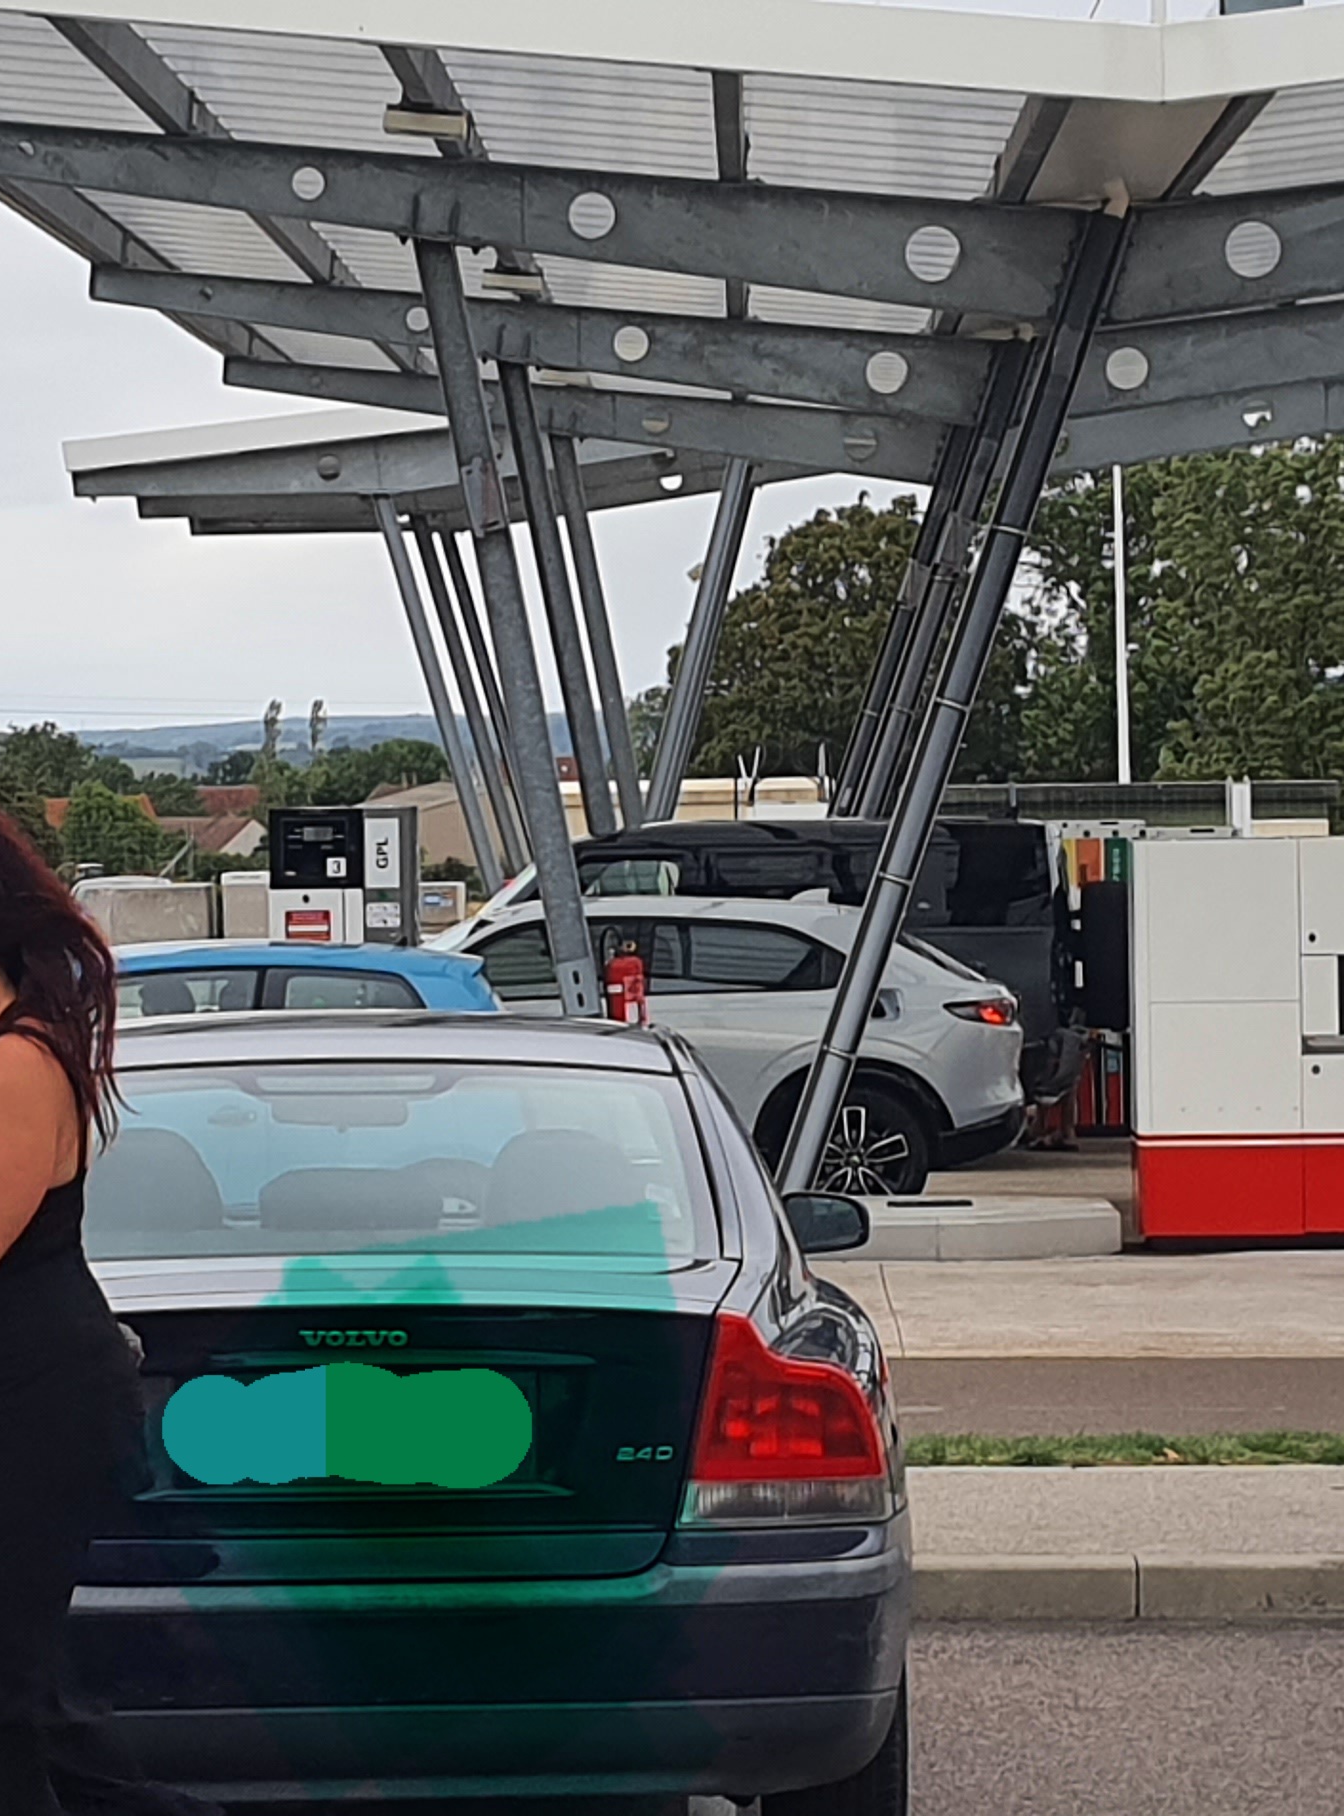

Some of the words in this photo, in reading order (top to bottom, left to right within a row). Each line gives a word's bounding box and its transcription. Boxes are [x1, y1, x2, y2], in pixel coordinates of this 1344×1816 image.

[376, 837, 389, 869] GPL
[332, 860, 341, 874] 3
[298, 1330, 409, 1347] VOLVO
